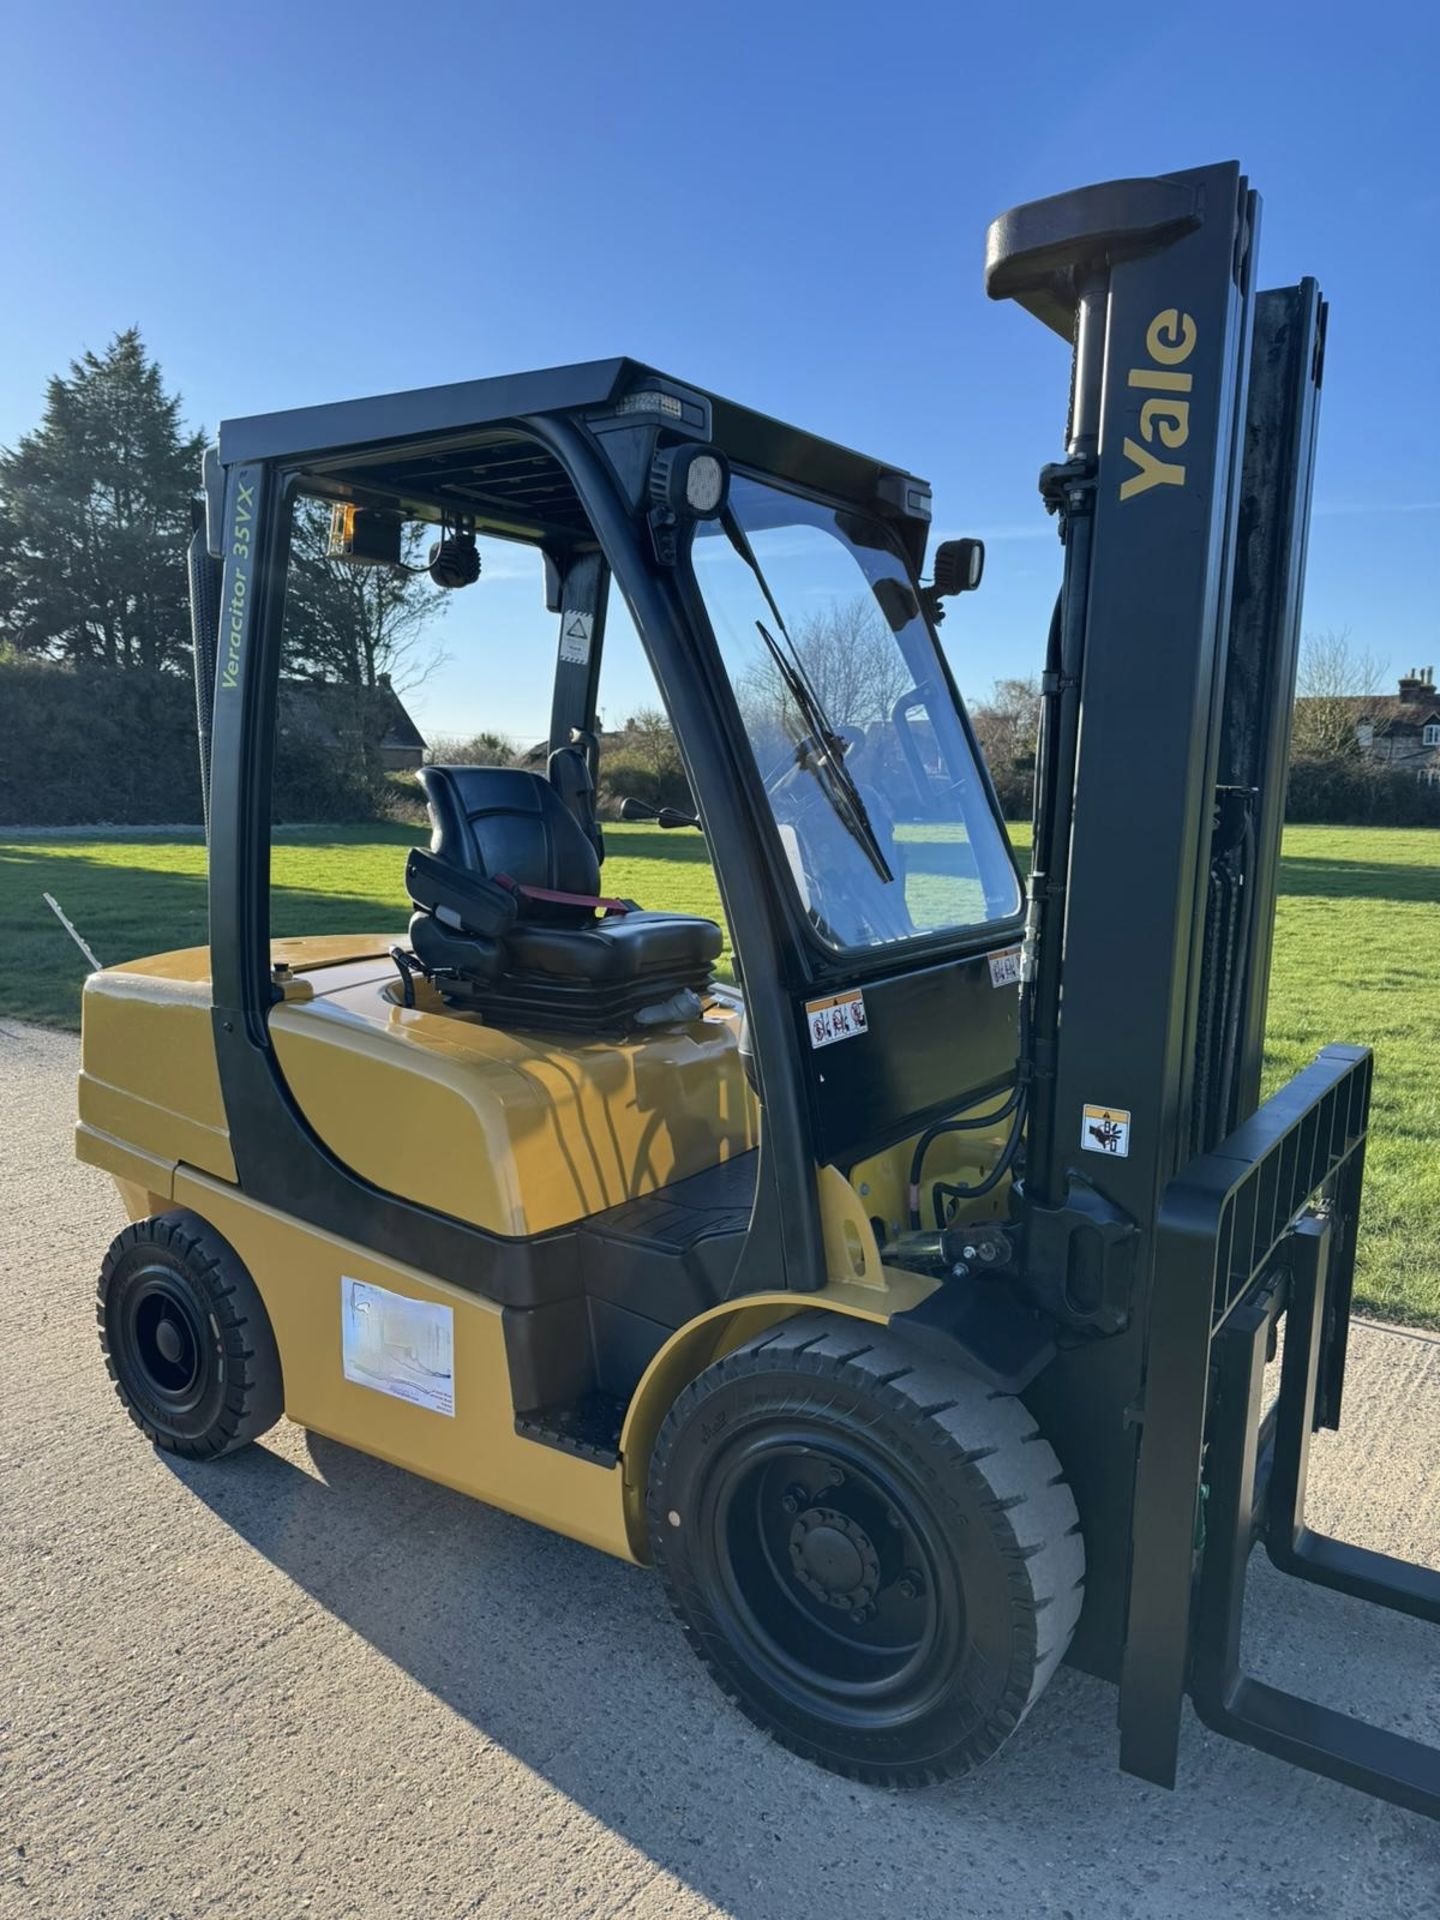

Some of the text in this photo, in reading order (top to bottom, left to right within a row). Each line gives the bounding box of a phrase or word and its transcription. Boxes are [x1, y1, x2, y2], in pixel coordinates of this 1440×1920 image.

[1120, 308, 1197, 500] Yale
[222, 482, 254, 688] Veracitor 35VX
